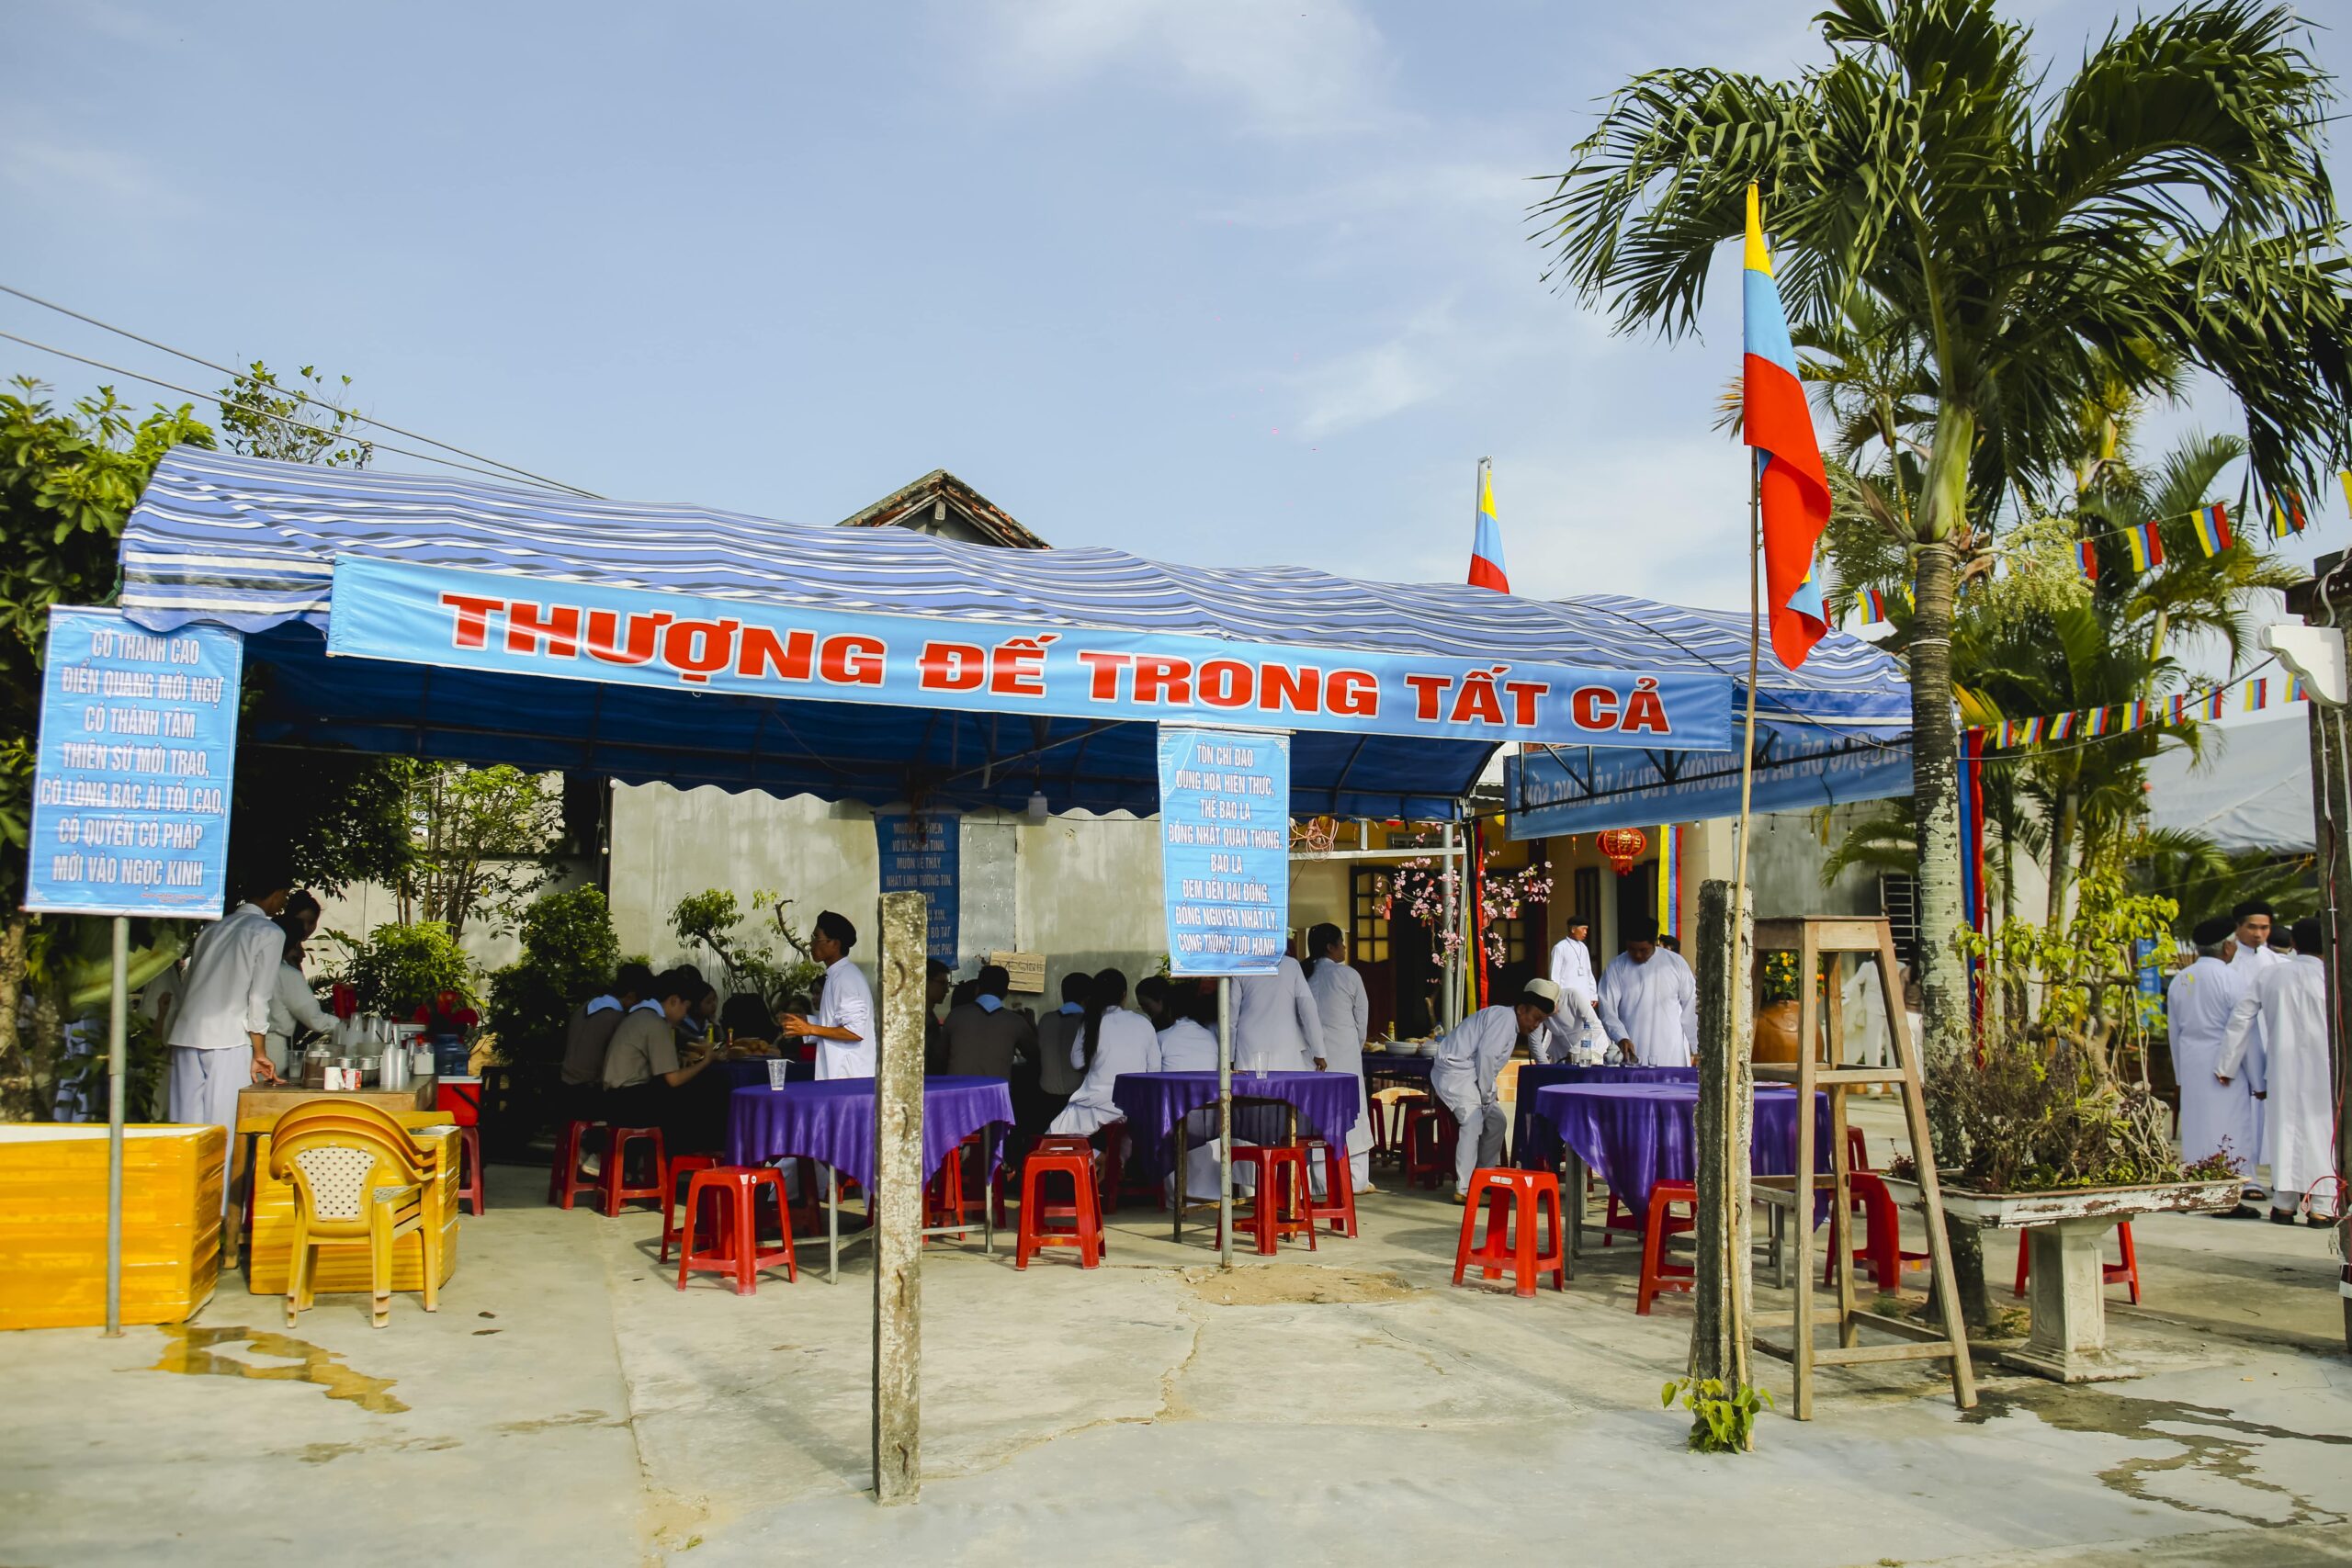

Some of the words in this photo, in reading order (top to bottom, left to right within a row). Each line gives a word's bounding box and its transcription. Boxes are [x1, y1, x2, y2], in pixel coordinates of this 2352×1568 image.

[118, 634, 166, 662] THANH
[171, 637, 199, 665] CAO
[438, 591, 888, 687] THƯỢNG
[917, 634, 1061, 699] ĐẾ
[1077, 649, 1382, 719] TRONG
[1404, 663, 1551, 728] TẤT
[1570, 675, 1673, 736] CẢ
[103, 671, 154, 699] QUANG
[158, 671, 187, 701] MỚI
[191, 676, 224, 709] NGỰ
[85, 702, 106, 732] CÓ
[110, 704, 160, 735] THÁNH
[164, 706, 197, 739] TÂM
[62, 739, 108, 770] THIÊN
[136, 742, 166, 773] MỚI
[170, 750, 209, 779] TRAO,
[1196, 741, 1214, 764] TÔN
[1216, 742, 1233, 766] CHỈ
[1234, 749, 1253, 772] ĐẠO
[40, 774, 62, 806] CÓ
[65, 774, 107, 807] LÒNG
[110, 779, 143, 810] BÁC
[145, 779, 162, 811] ÁI
[165, 777, 189, 812] TỐI
[192, 787, 225, 818] CAO,
[1224, 772, 1246, 797] HIỆN
[1219, 800, 1237, 819] BAO
[1239, 803, 1251, 820] LA
[58, 813, 80, 844] CÓ
[138, 817, 159, 848] CÓ
[162, 818, 204, 850] PHÁP
[52, 851, 85, 882] MỚI
[87, 852, 118, 884] VÀO
[121, 858, 164, 891] NGỌC
[166, 861, 204, 887] KINH
[1210, 853, 1229, 873] BAO
[1231, 854, 1243, 874] LA
[1182, 880, 1203, 898] ĐEM
[1205, 875, 1224, 900] ĐẾN
[1227, 882, 1240, 905] ĐẠI
[1203, 906, 1239, 927] NGUYÊN
[1204, 931, 1232, 953] THÔNG
